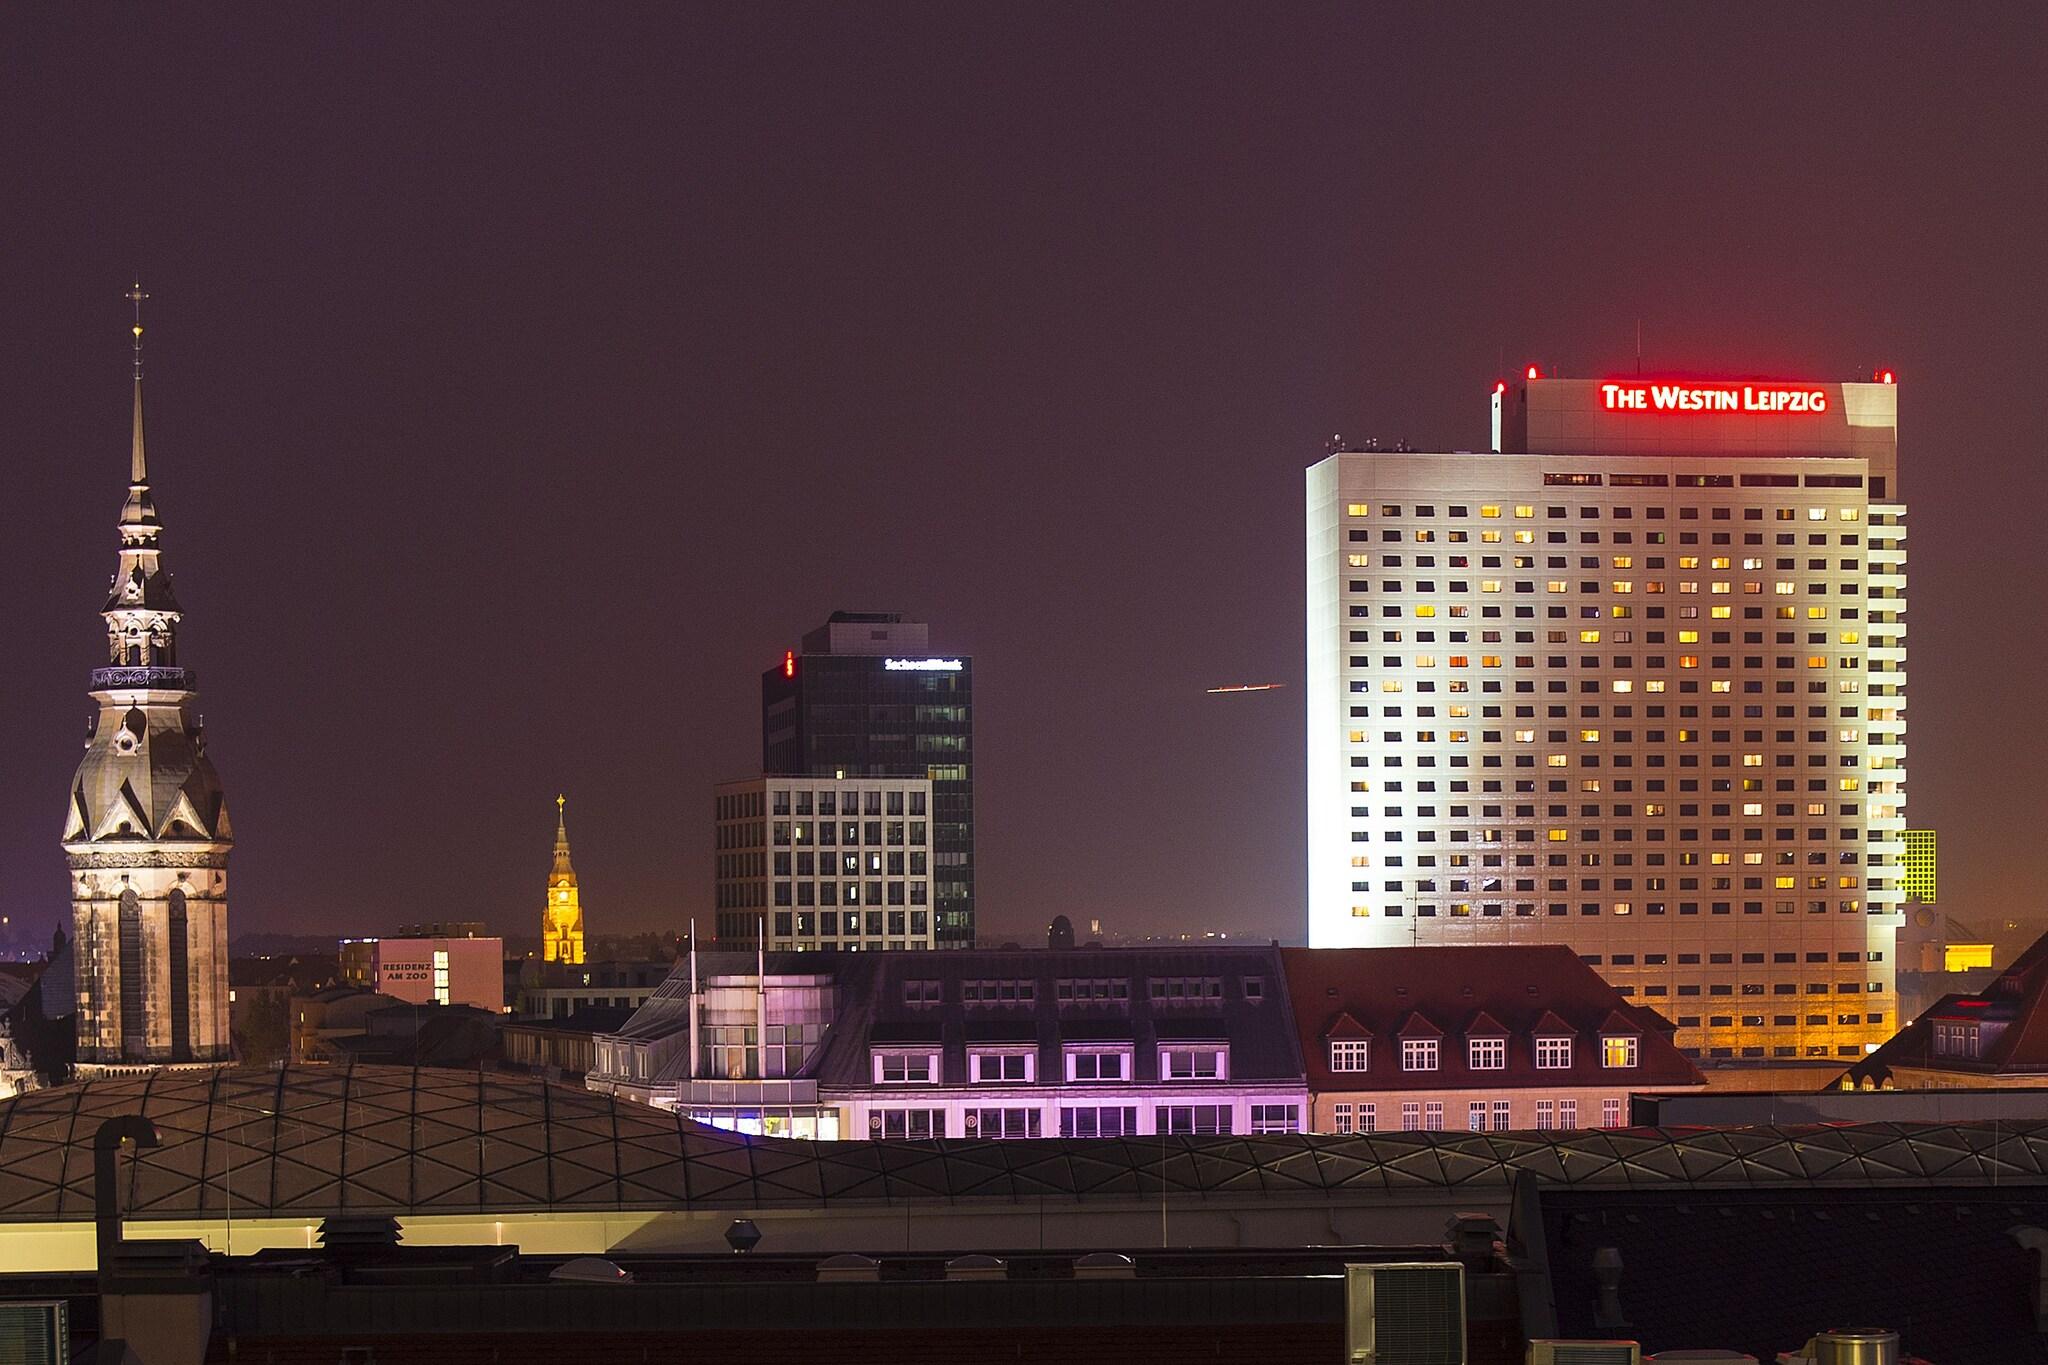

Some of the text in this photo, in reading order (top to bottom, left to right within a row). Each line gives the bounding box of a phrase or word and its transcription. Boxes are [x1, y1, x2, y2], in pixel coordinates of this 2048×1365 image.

[1602, 384, 1825, 411] THE WESTIN LEIPZIG
[383, 963, 432, 971] RESIDENZ
